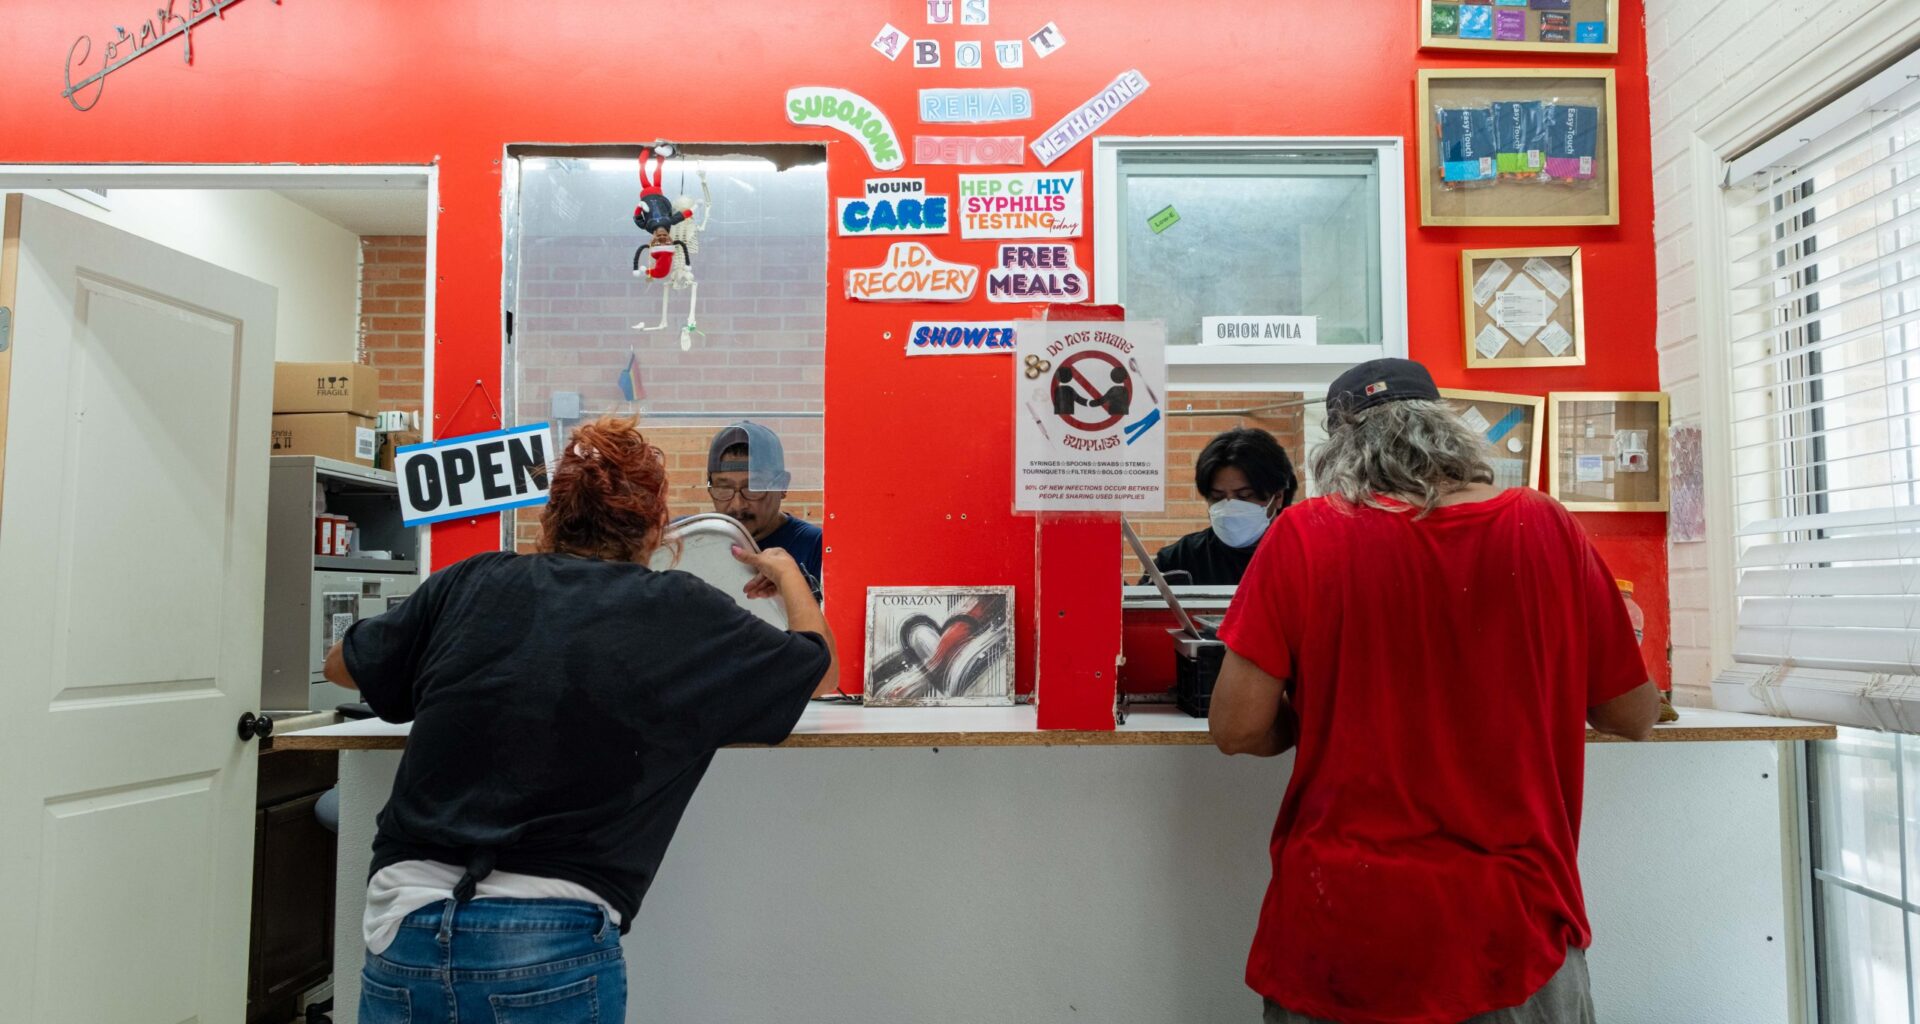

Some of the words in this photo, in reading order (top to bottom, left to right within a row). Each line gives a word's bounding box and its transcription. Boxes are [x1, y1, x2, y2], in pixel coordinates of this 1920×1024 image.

[928, 0, 986, 23] US
[874, 26, 1055, 67] ABOUT
[923, 91, 1029, 119] REHAB
[1035, 73, 1143, 161] METHADONE
[789, 95, 897, 163] SUBOXONE
[918, 138, 1022, 163] DETOX
[867, 181, 922, 194] WOUND
[961, 179, 1002, 196] HEP
[1008, 179, 1023, 195] C
[842, 197, 947, 232] CARE
[965, 212, 1054, 230] TESTING
[893, 246, 931, 268] I.D.
[1002, 247, 1068, 269] FREE
[853, 268, 976, 297] RECOVERY
[990, 274, 1081, 296] MEALS
[913, 326, 1016, 349] SHOWER
[1217, 323, 1259, 338] ORION
[1264, 323, 1301, 338] AVILA
[1046, 340, 1064, 357] DO
[1094, 331, 1134, 354] SHARE
[1063, 434, 1120, 451] SUPPLIES
[405, 434, 549, 512] OPEN
[882, 595, 942, 606] CORAZON
